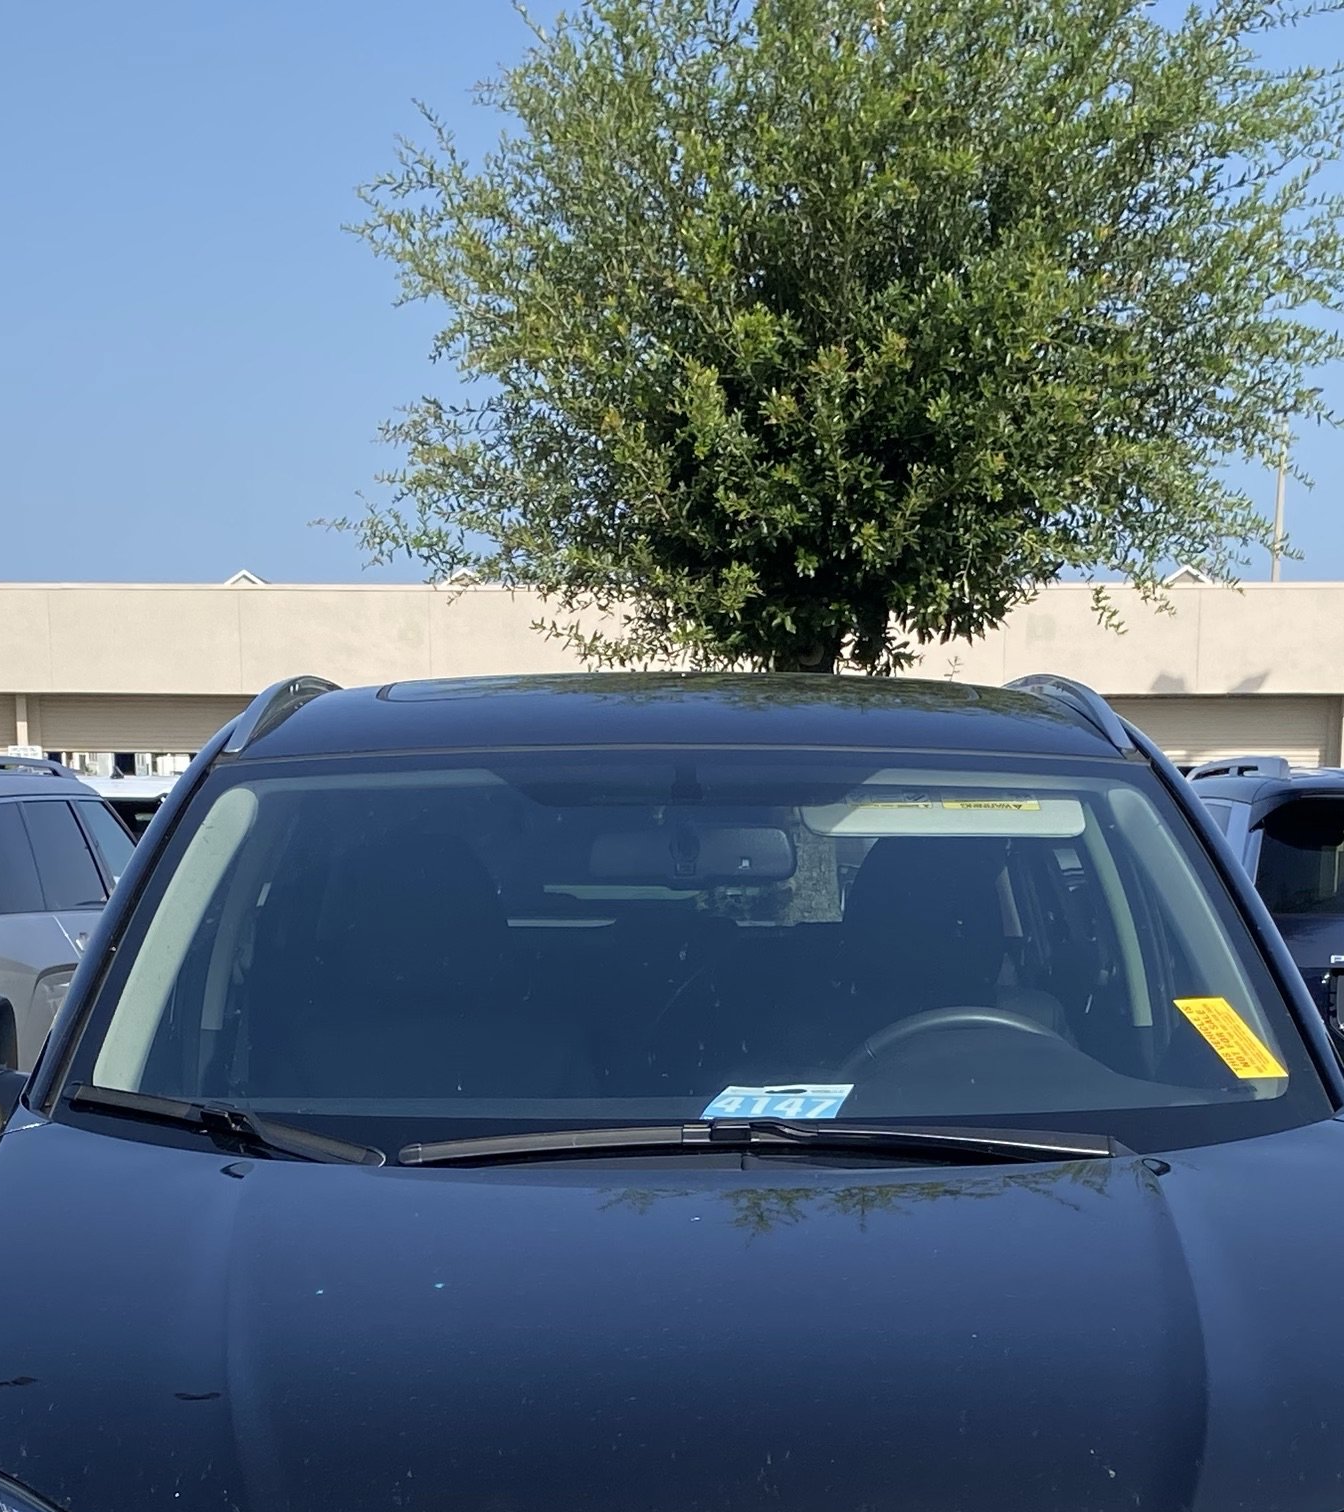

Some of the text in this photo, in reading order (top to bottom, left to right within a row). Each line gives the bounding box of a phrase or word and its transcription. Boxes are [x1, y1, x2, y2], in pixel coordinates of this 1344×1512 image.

[1182, 1005, 1243, 1072] THIS VEHICLE IS
[1195, 1009, 1251, 1068] NOT FOR SALE
[712, 1096, 838, 1118] 4147
